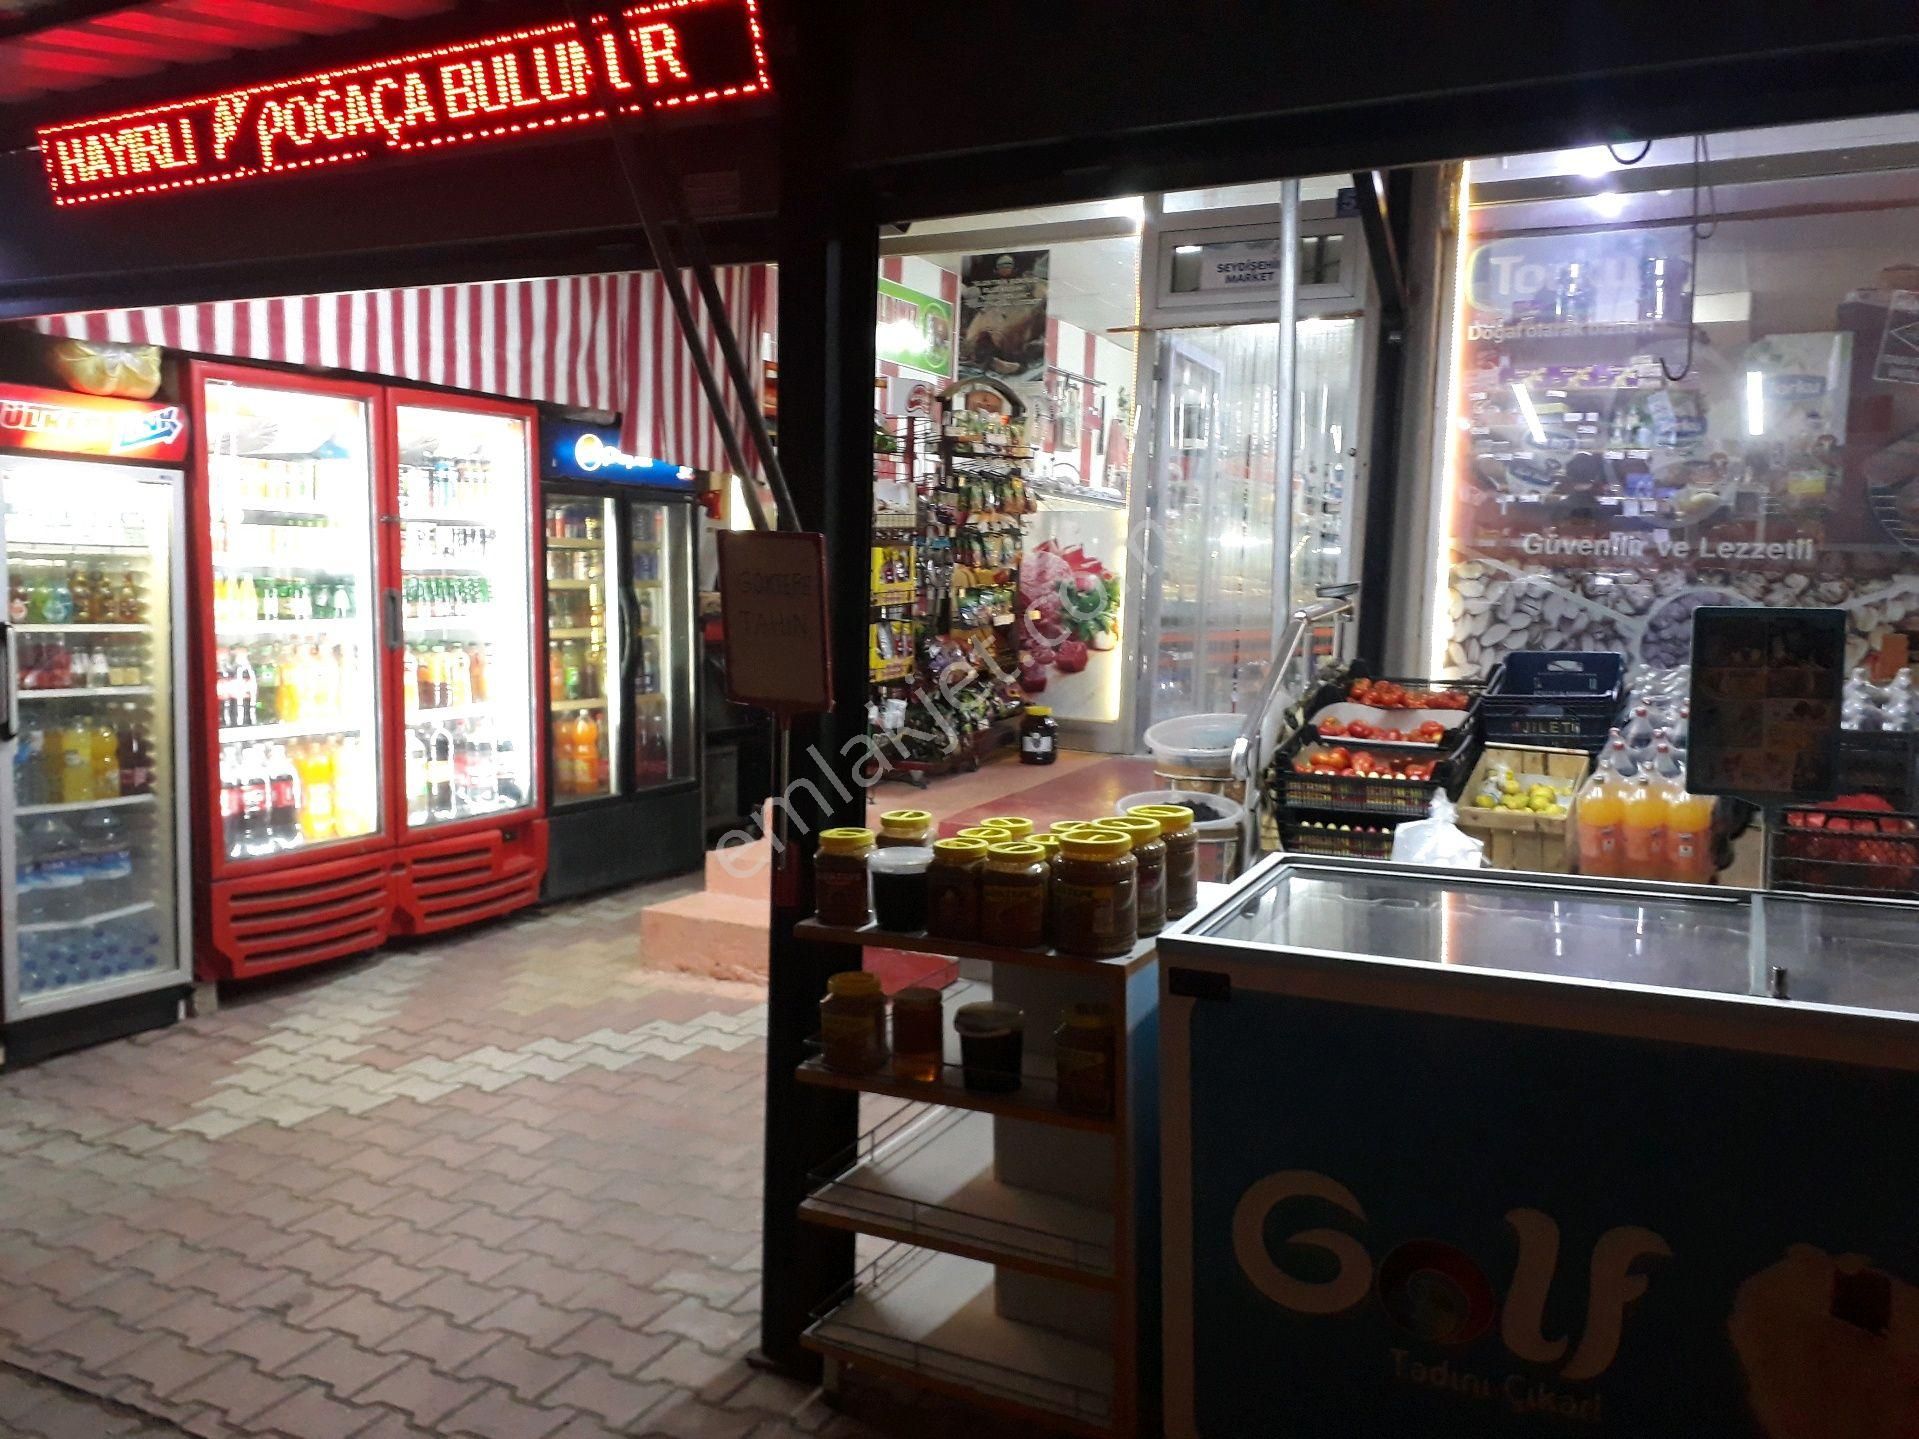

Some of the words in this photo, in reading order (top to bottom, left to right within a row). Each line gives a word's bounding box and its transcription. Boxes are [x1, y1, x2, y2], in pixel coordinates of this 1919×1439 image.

[56, 118, 198, 185] HAYIRLI
[1225, 271, 1276, 284] MARKET
[1655, 540, 1690, 559] ve
[1700, 537, 1813, 561] Lezzetli
